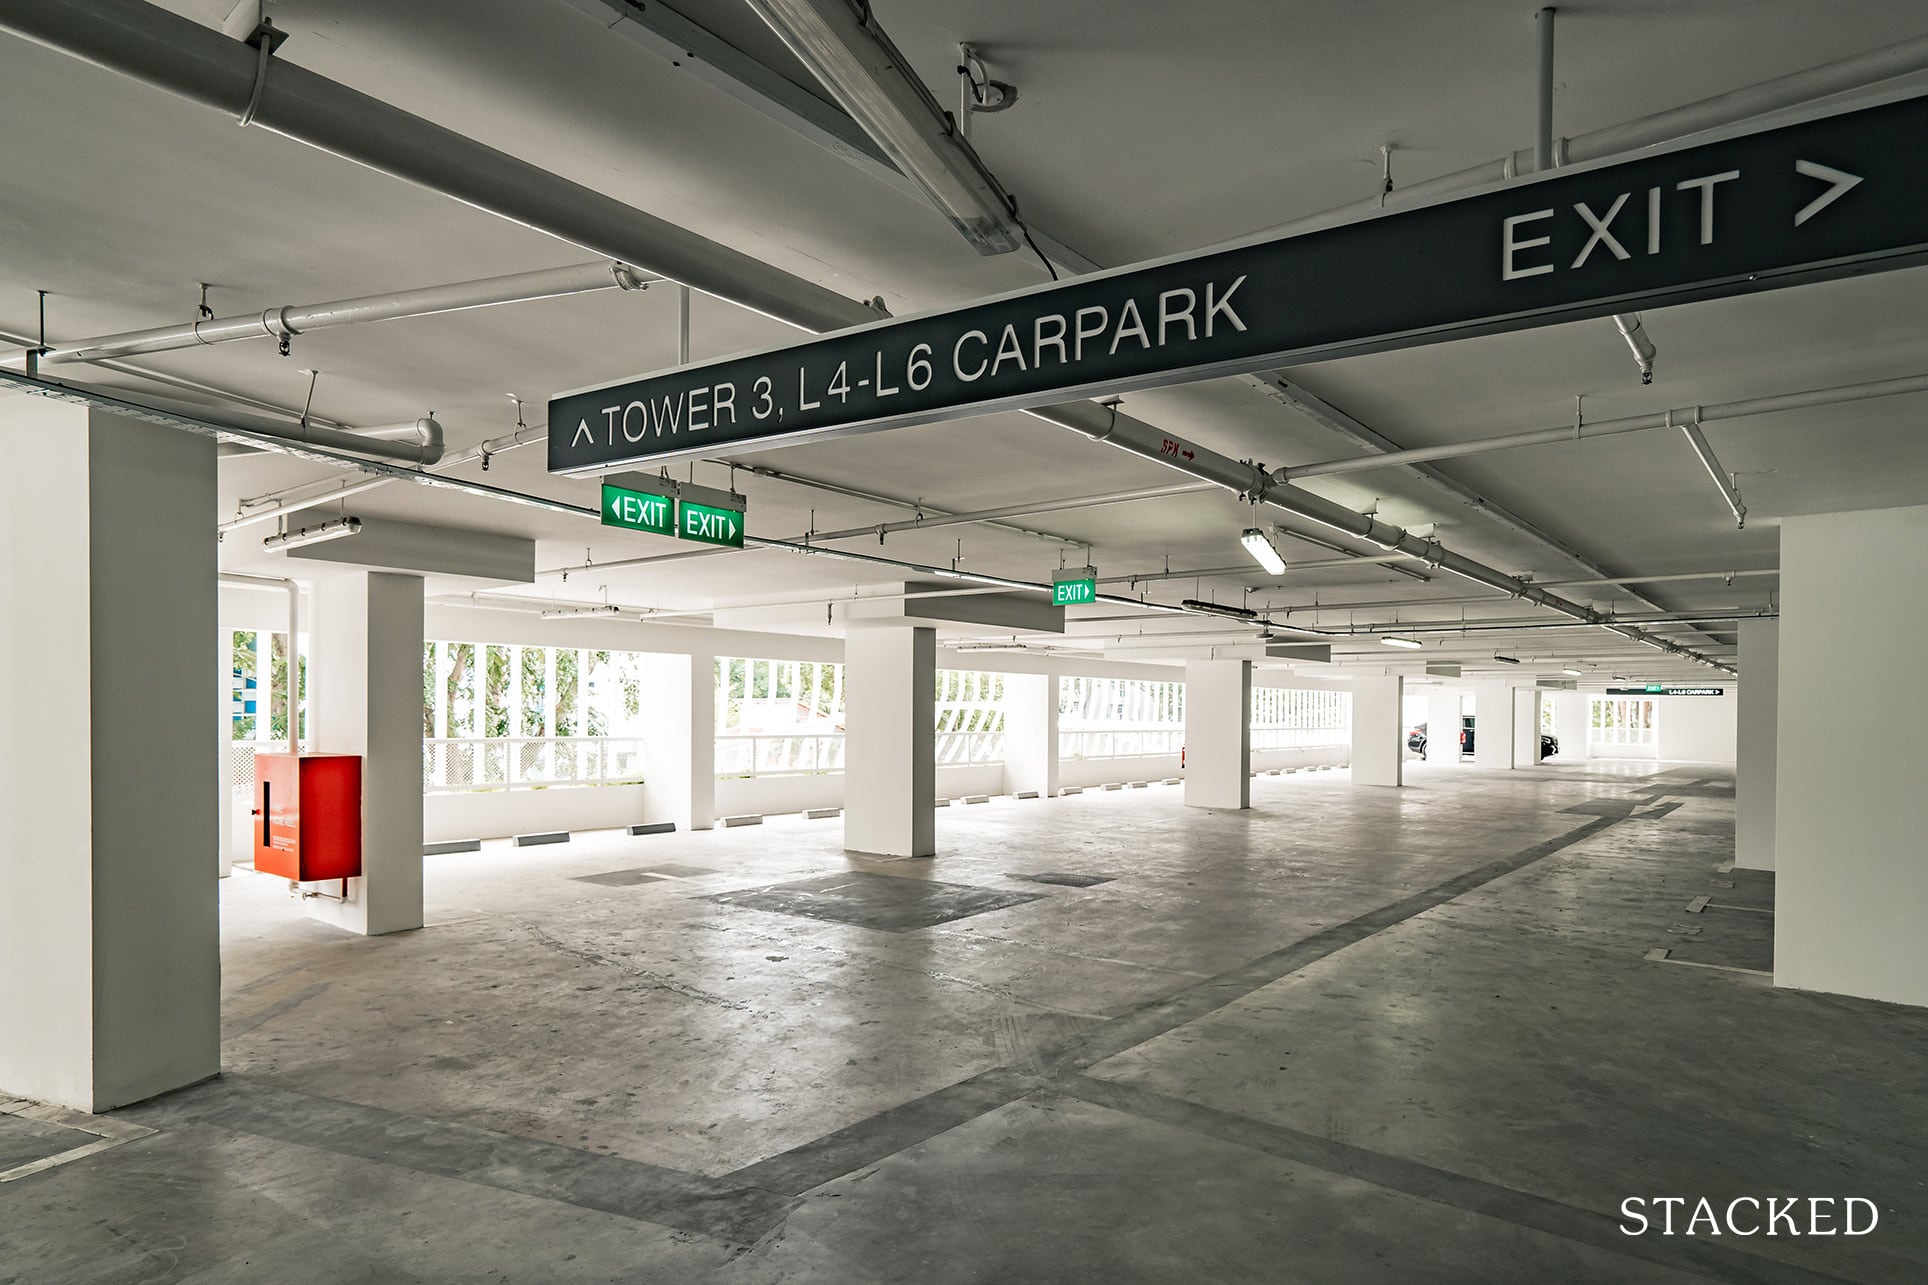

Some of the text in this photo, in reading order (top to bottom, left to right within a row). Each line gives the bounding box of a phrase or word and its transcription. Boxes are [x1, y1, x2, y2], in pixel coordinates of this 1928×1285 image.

[1503, 170, 1740, 281] EXIT
[601, 274, 1248, 446] TOWER 3, L4-L6 CARPARK
[623, 496, 666, 528] EXIT
[686, 510, 726, 539] EXIT
[1057, 584, 1083, 601] EXIT
